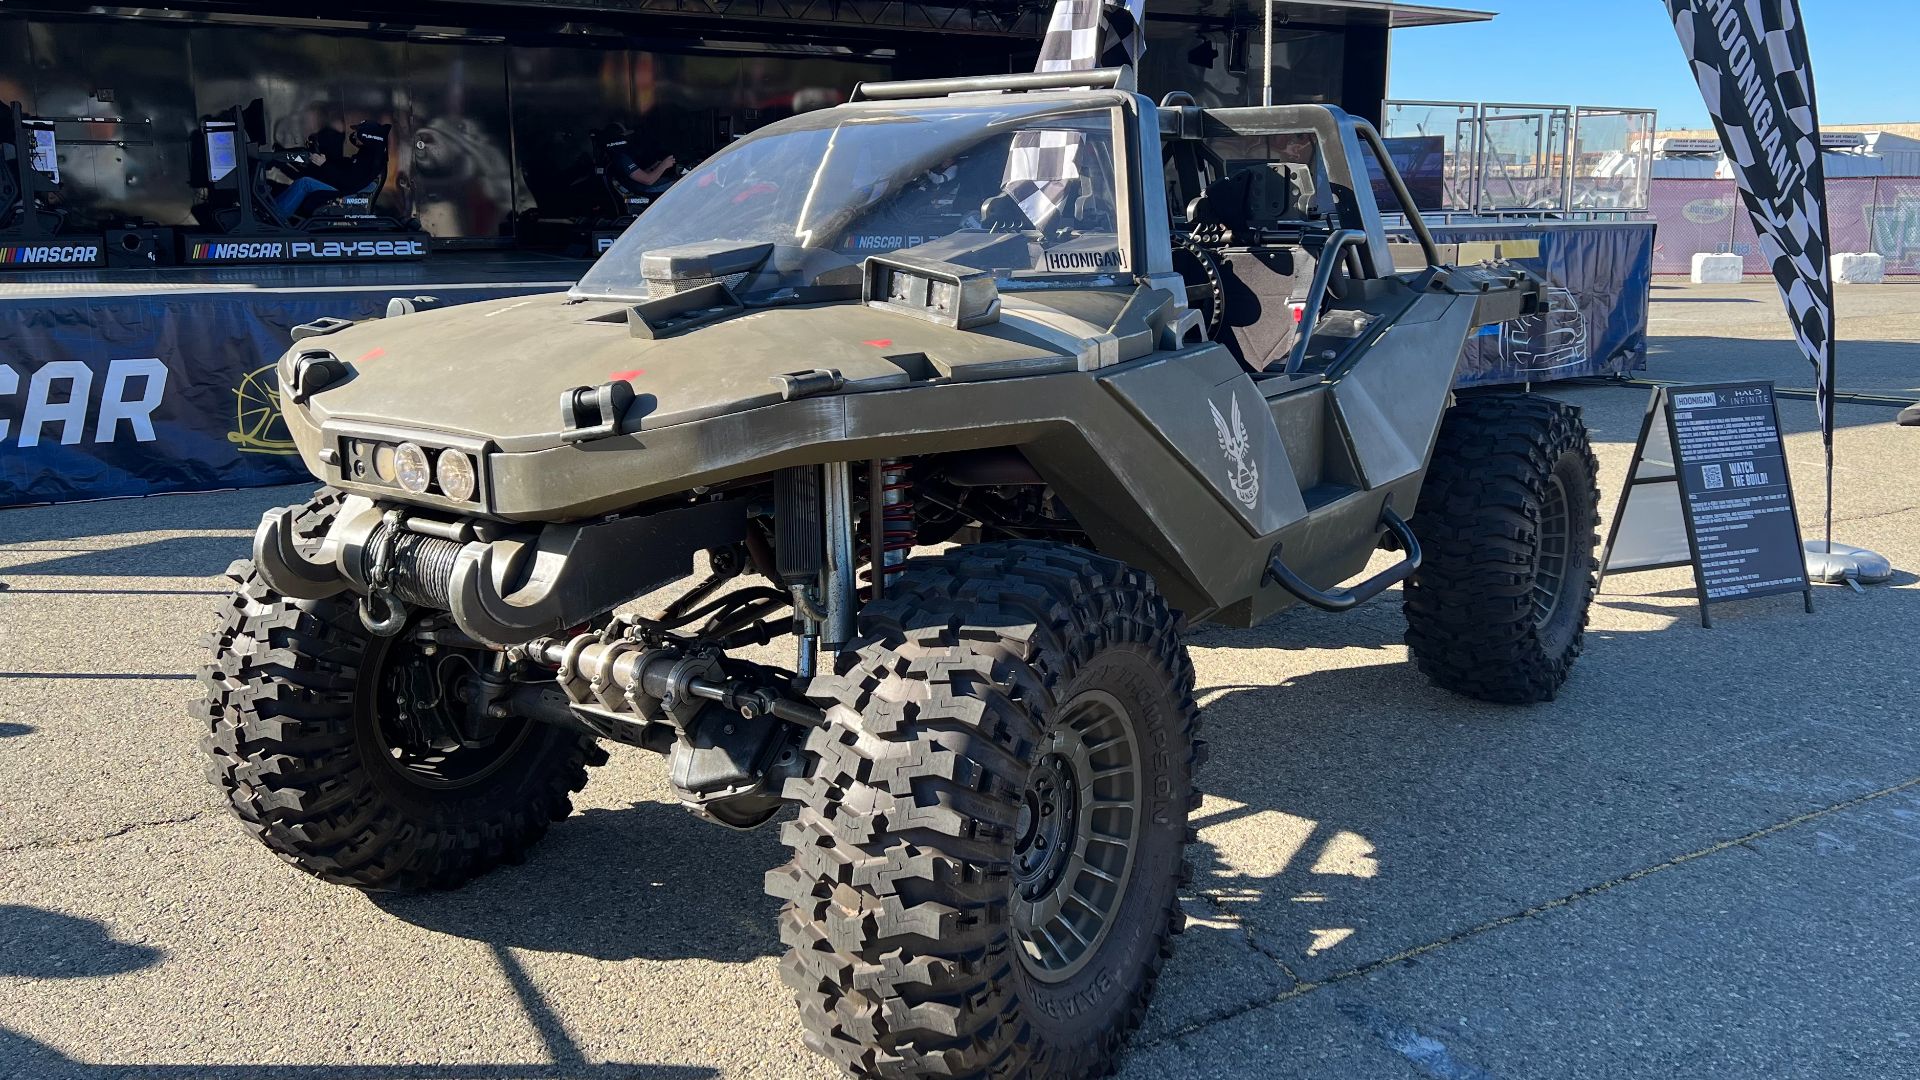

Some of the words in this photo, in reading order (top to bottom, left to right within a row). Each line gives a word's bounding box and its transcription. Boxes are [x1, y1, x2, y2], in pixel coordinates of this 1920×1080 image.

[859, 235, 902, 249] NASCAR
[23, 246, 98, 263] NASCAR
[214, 243, 283, 259] NASCAR
[1730, 394, 1769, 406] INFINITE
[1735, 388, 1762, 397] HALO
[1728, 461, 1755, 475] WATCH
[1730, 474, 1746, 488] THE
[1745, 472, 1769, 486] BUILD!
[1117, 666, 1172, 825] THOMPSON
